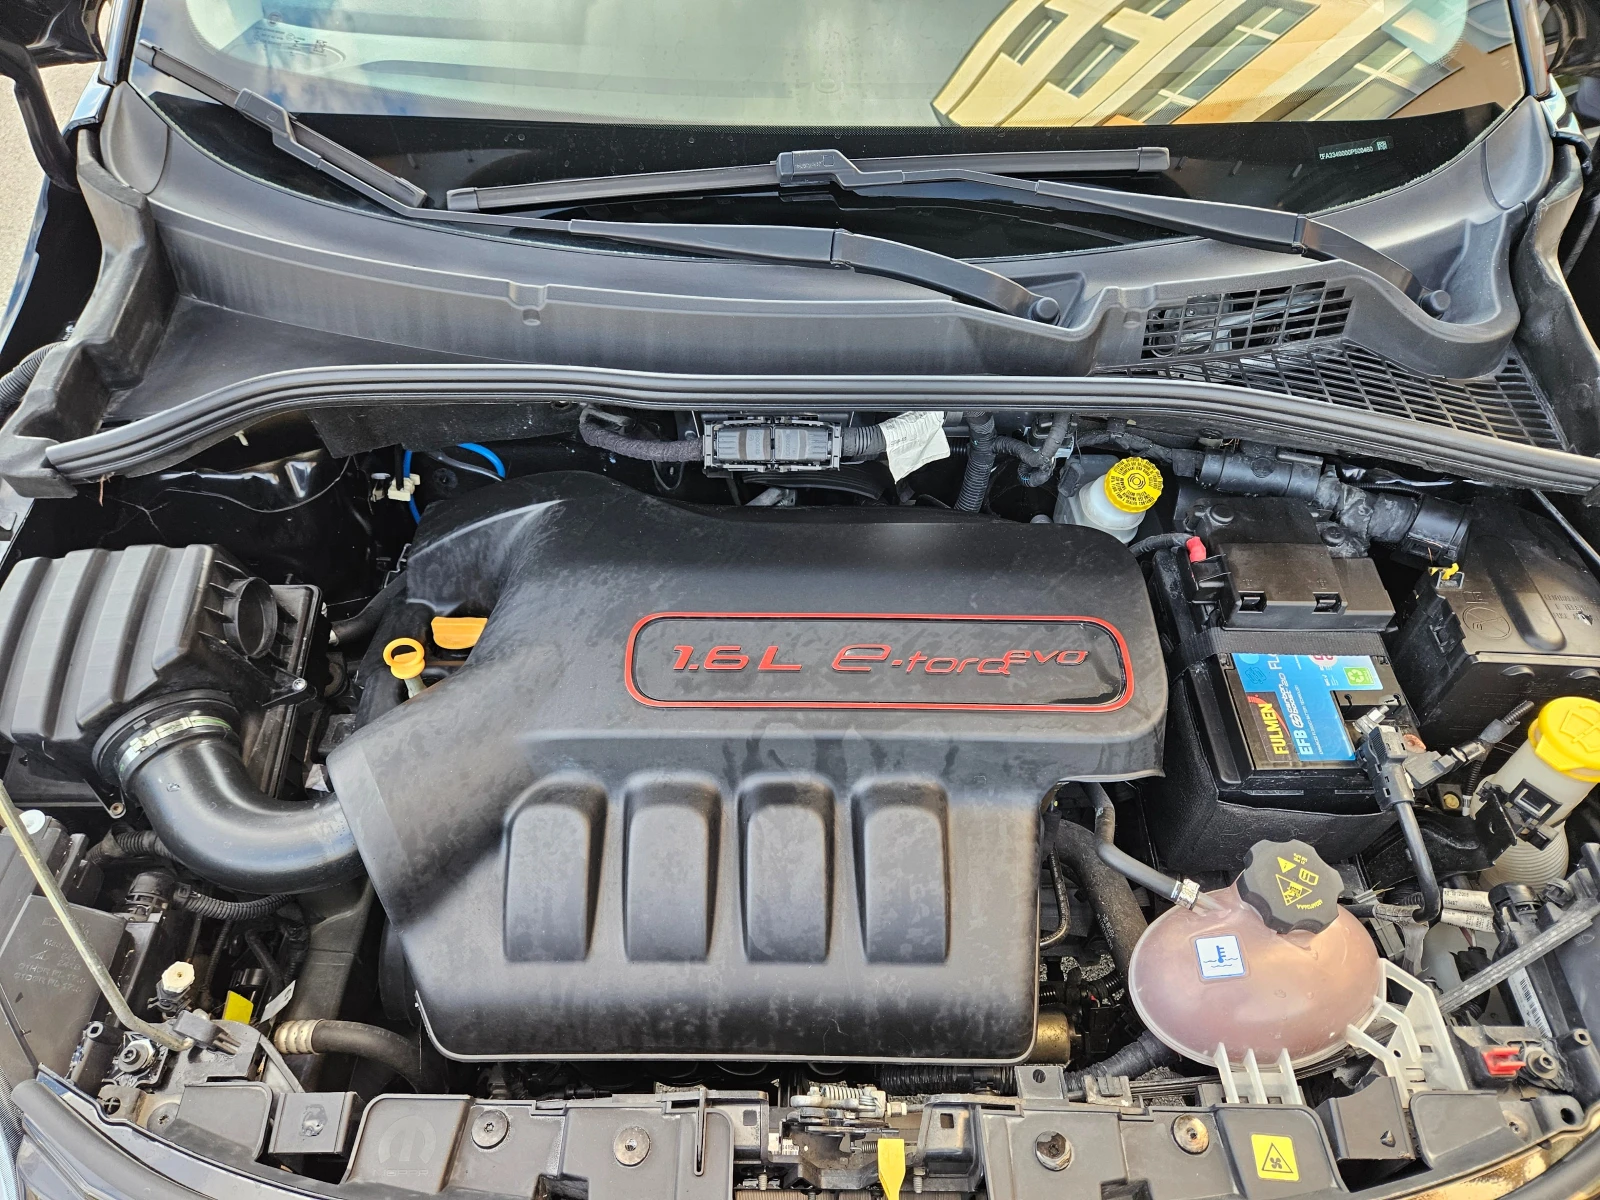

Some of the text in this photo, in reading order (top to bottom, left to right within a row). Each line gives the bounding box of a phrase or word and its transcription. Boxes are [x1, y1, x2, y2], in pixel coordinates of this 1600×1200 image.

[672, 644, 751, 671] 1.6
[757, 645, 802, 672] L
[1258, 702, 1289, 755] FULMEN
[1294, 729, 1314, 755] EFB
